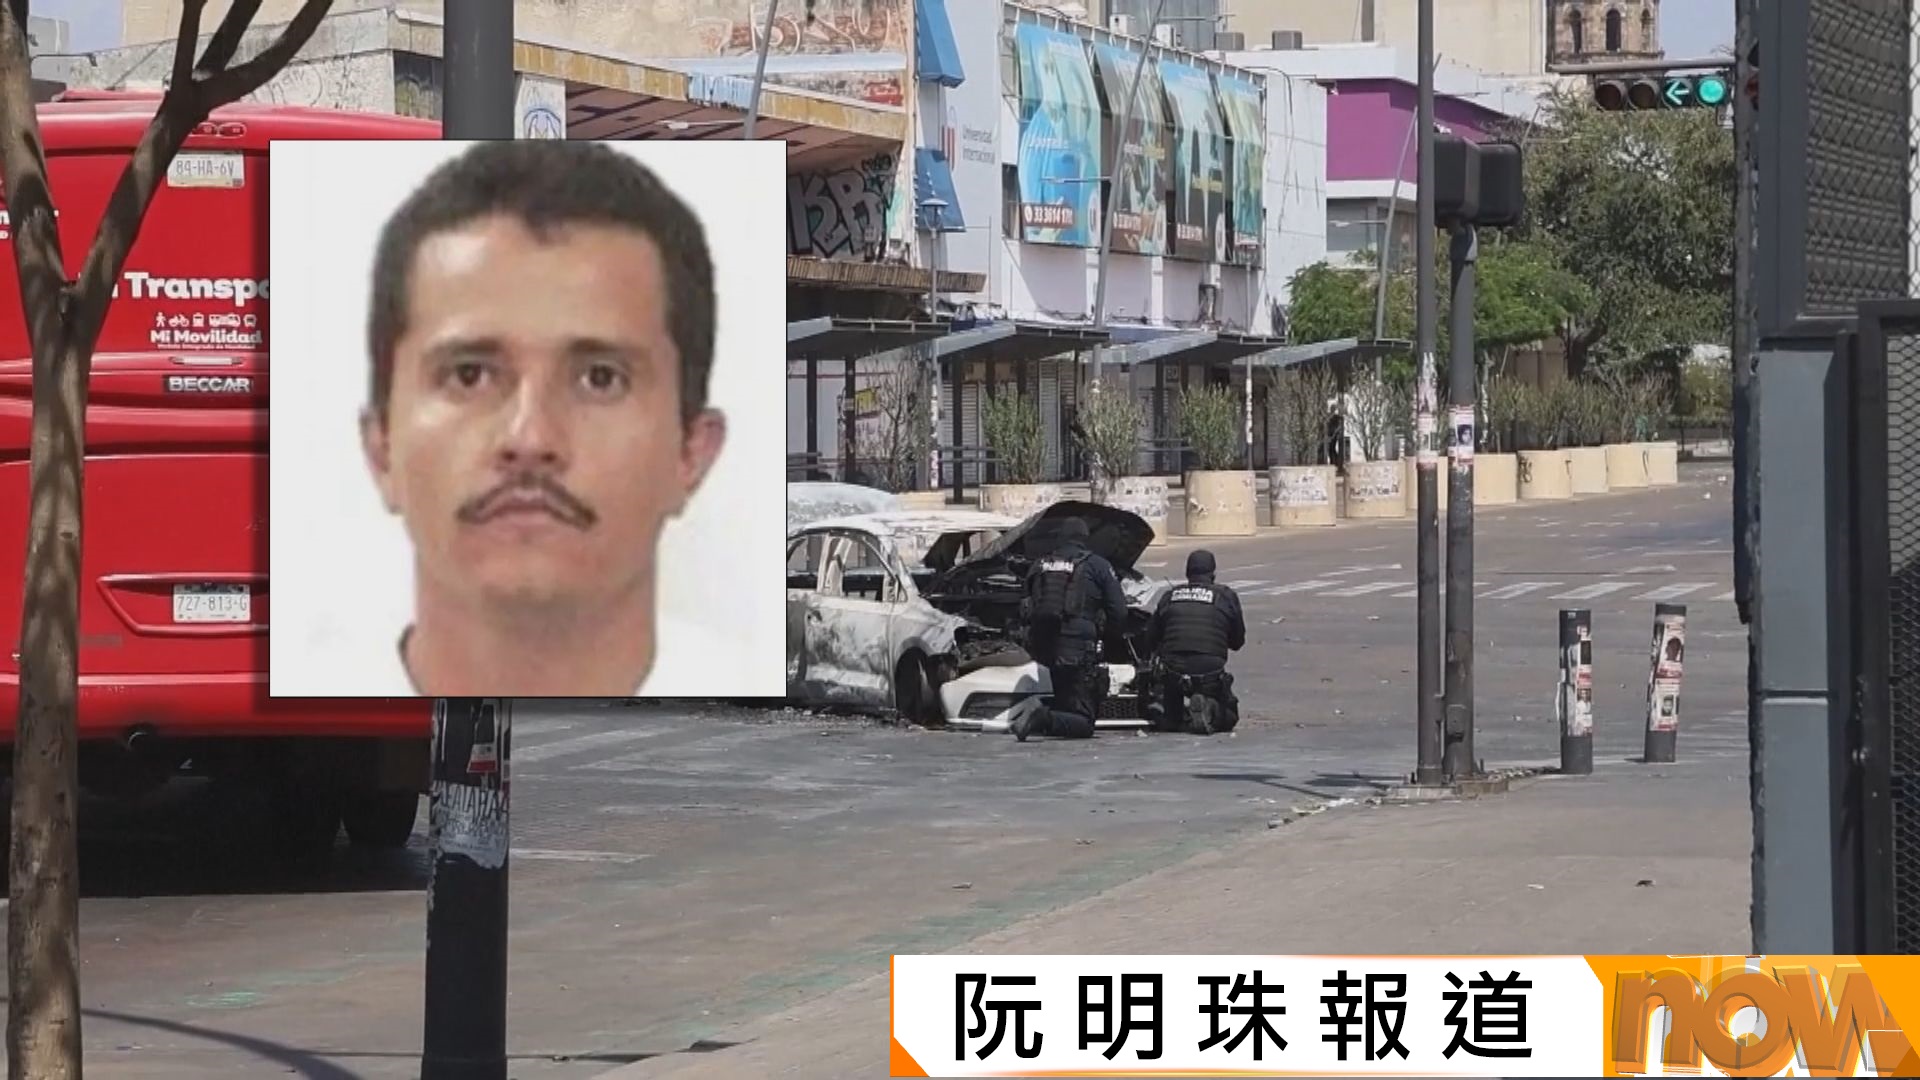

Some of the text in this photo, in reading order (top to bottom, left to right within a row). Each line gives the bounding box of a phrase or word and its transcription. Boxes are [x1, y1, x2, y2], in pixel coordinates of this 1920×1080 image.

[150, 328, 262, 344] Mi Movilidad
[168, 376, 251, 393] BECCAR
